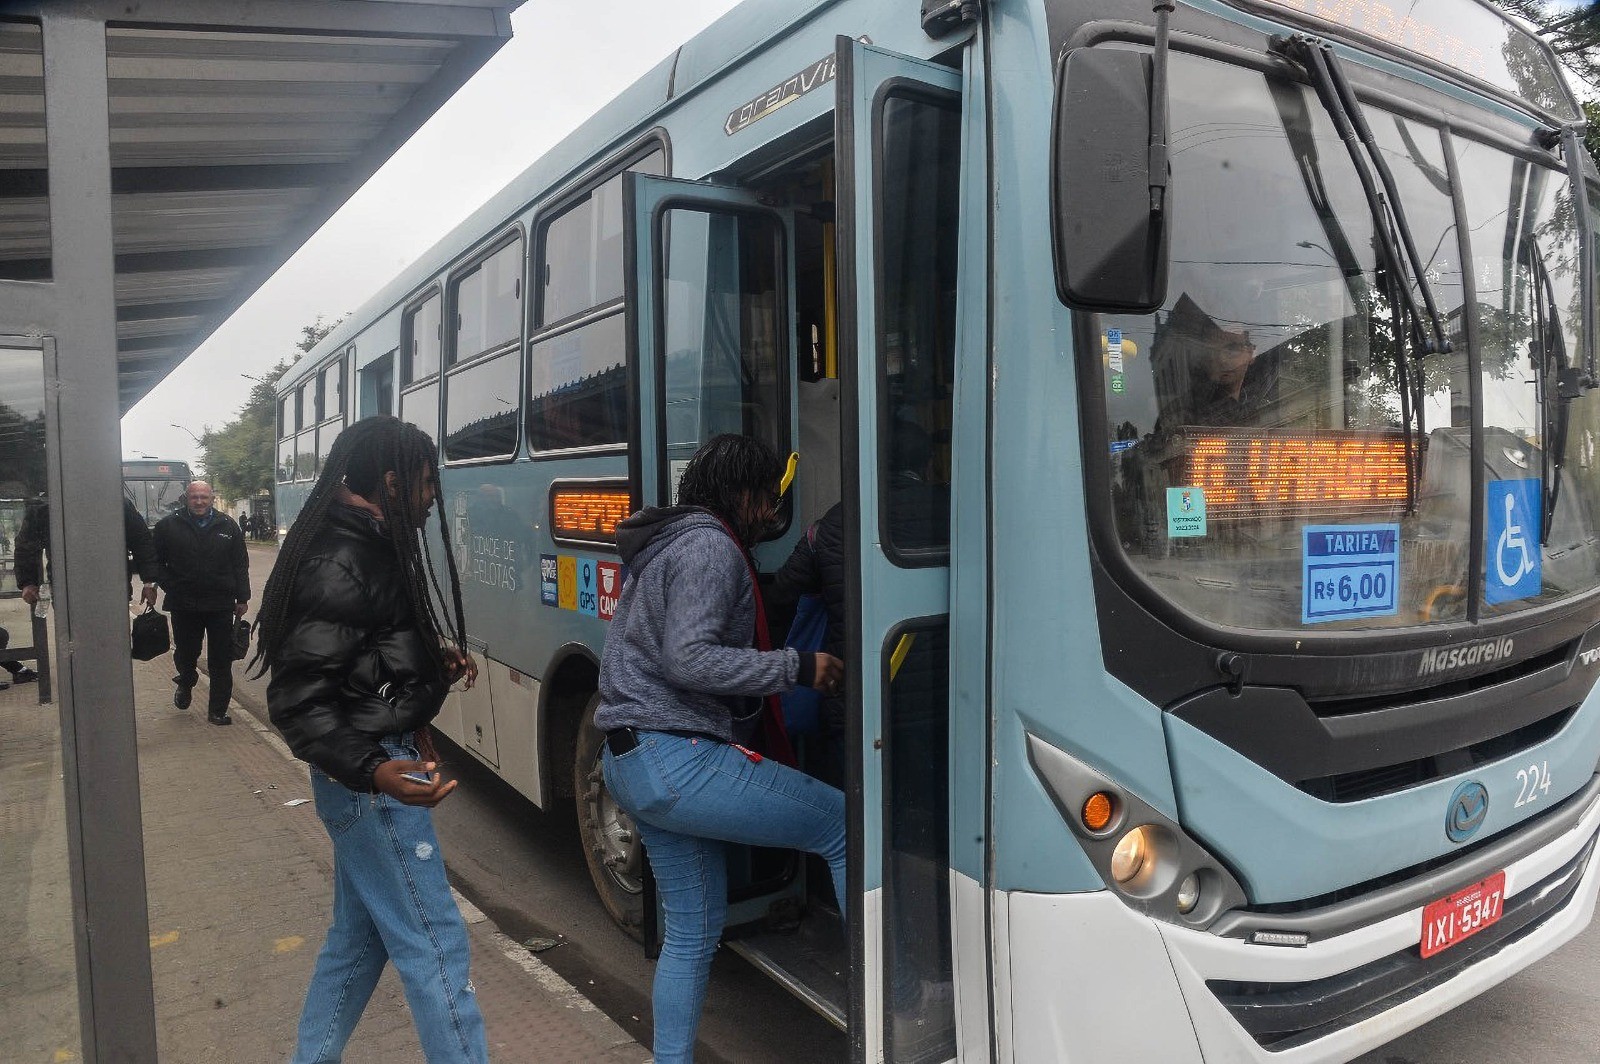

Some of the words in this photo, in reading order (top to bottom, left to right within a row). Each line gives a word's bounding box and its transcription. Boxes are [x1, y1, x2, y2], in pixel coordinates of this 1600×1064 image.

[1325, 533, 1380, 553] TARIFA
[580, 591, 596, 611] GPS
[1338, 573, 1387, 607] 6,00
[1416, 637, 1514, 678] Mascarello
[1513, 760, 1552, 809] 224
